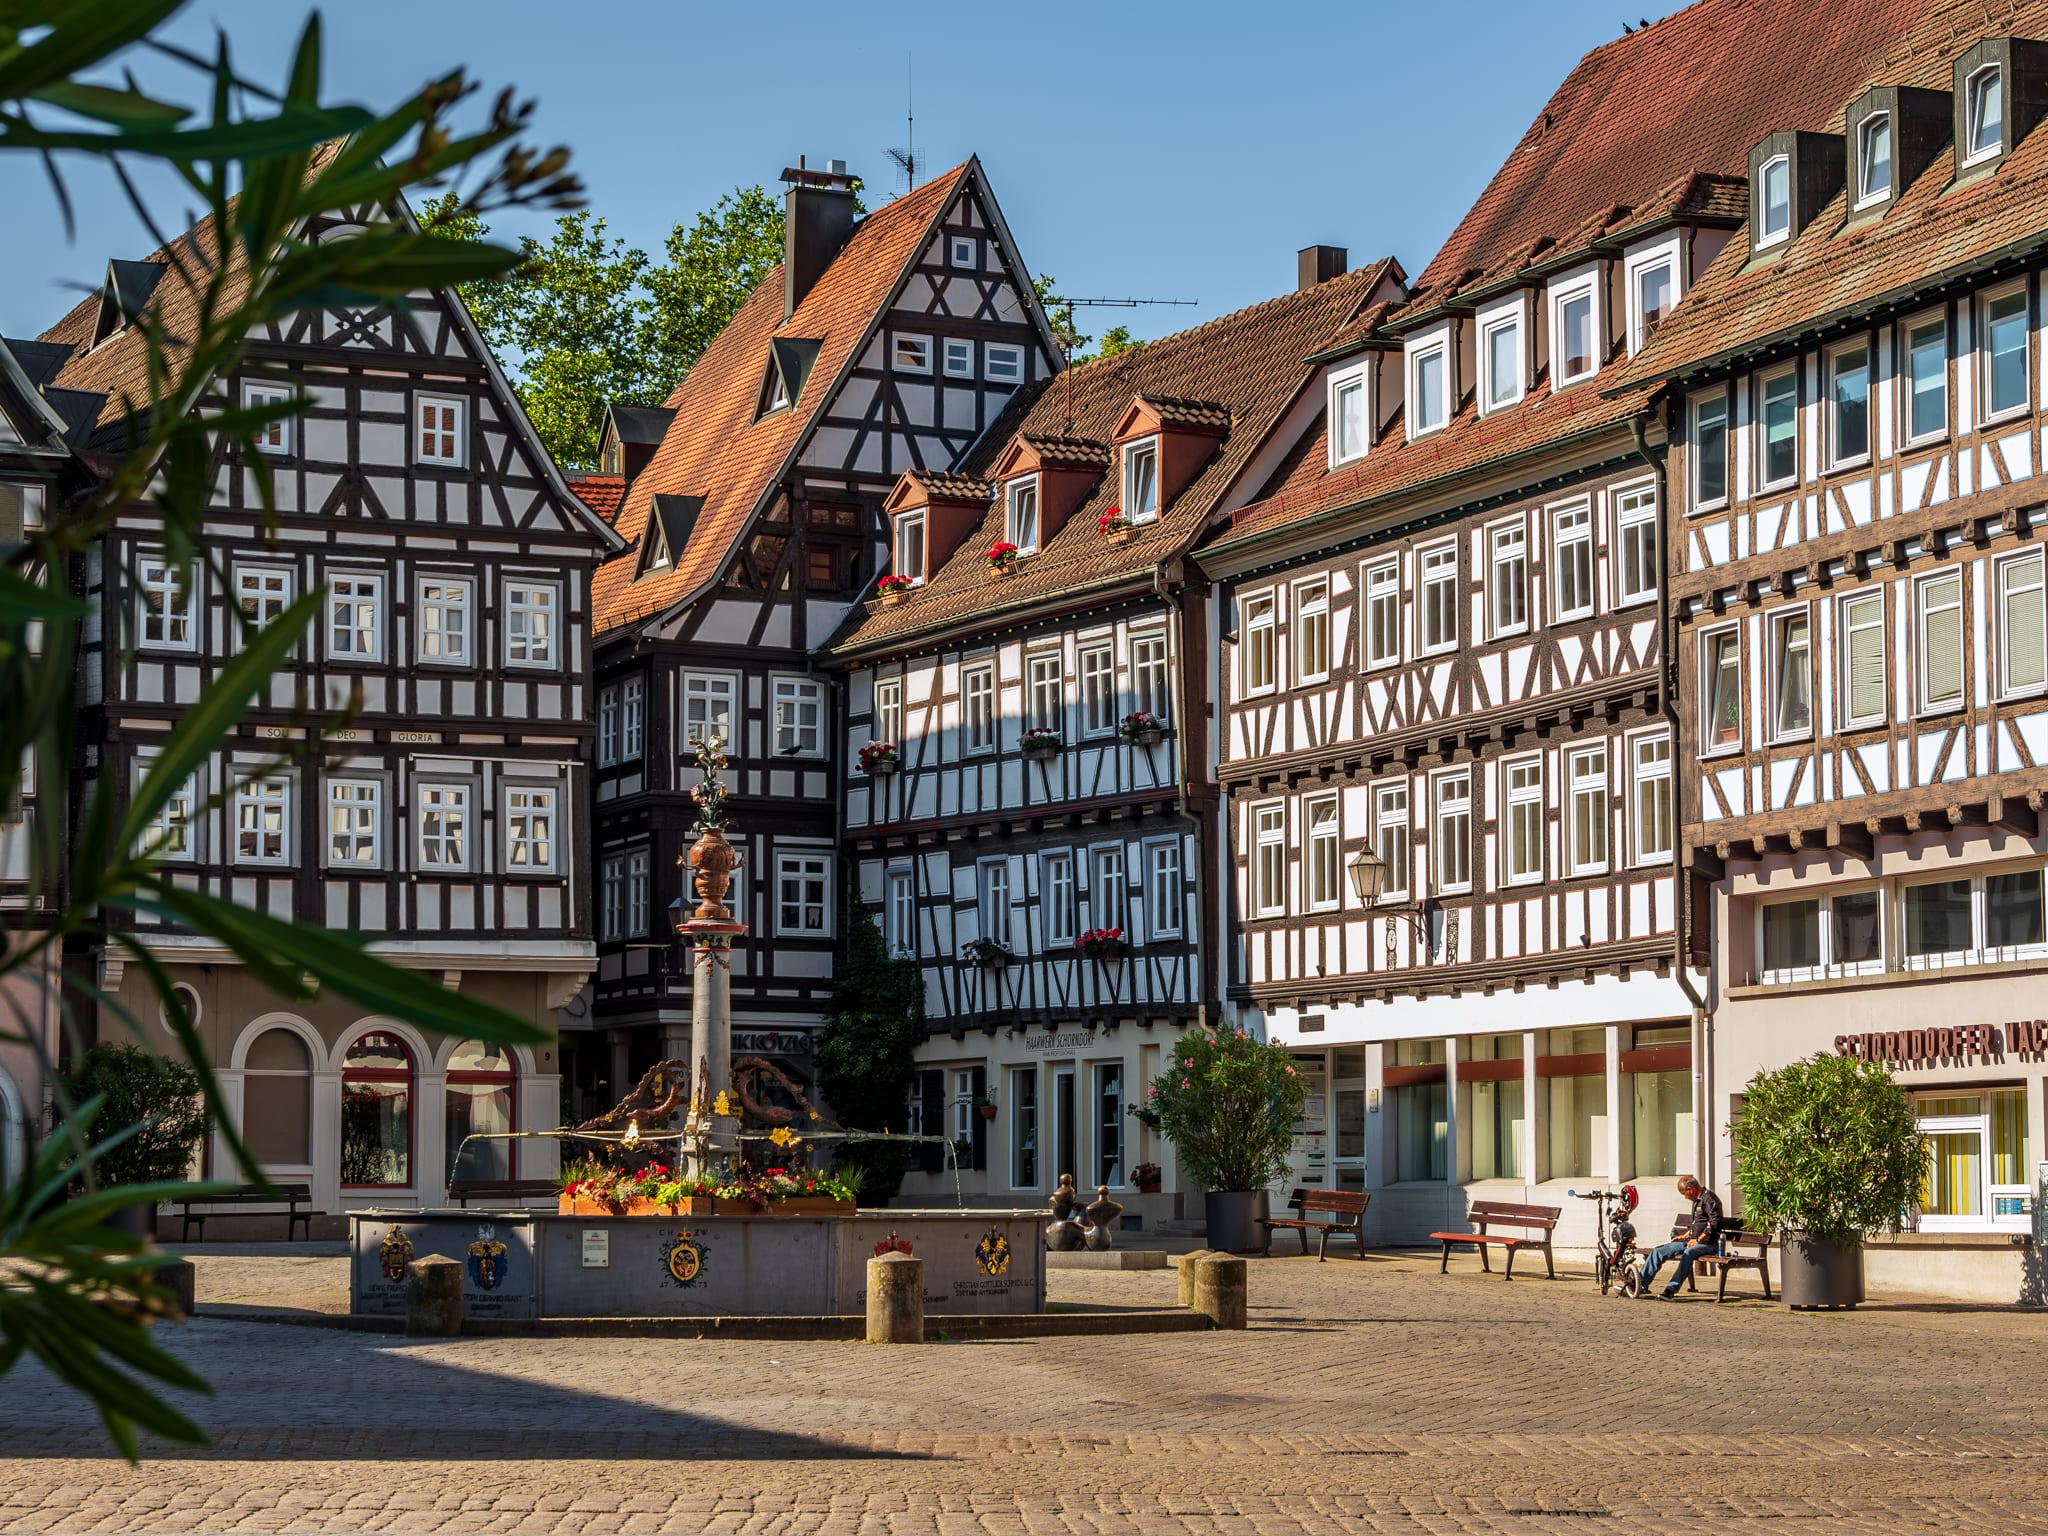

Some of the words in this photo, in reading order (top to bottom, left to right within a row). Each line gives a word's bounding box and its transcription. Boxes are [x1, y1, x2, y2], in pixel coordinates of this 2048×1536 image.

[337, 729, 357, 740] DEO
[398, 732, 434, 743] GLORIA
[1026, 1034, 1056, 1050] HAARWERK
[1056, 1031, 1095, 1048] SCHORNDORF
[1834, 1023, 1993, 1062] SCHORNDORFER
[544, 1051, 551, 1061] 9
